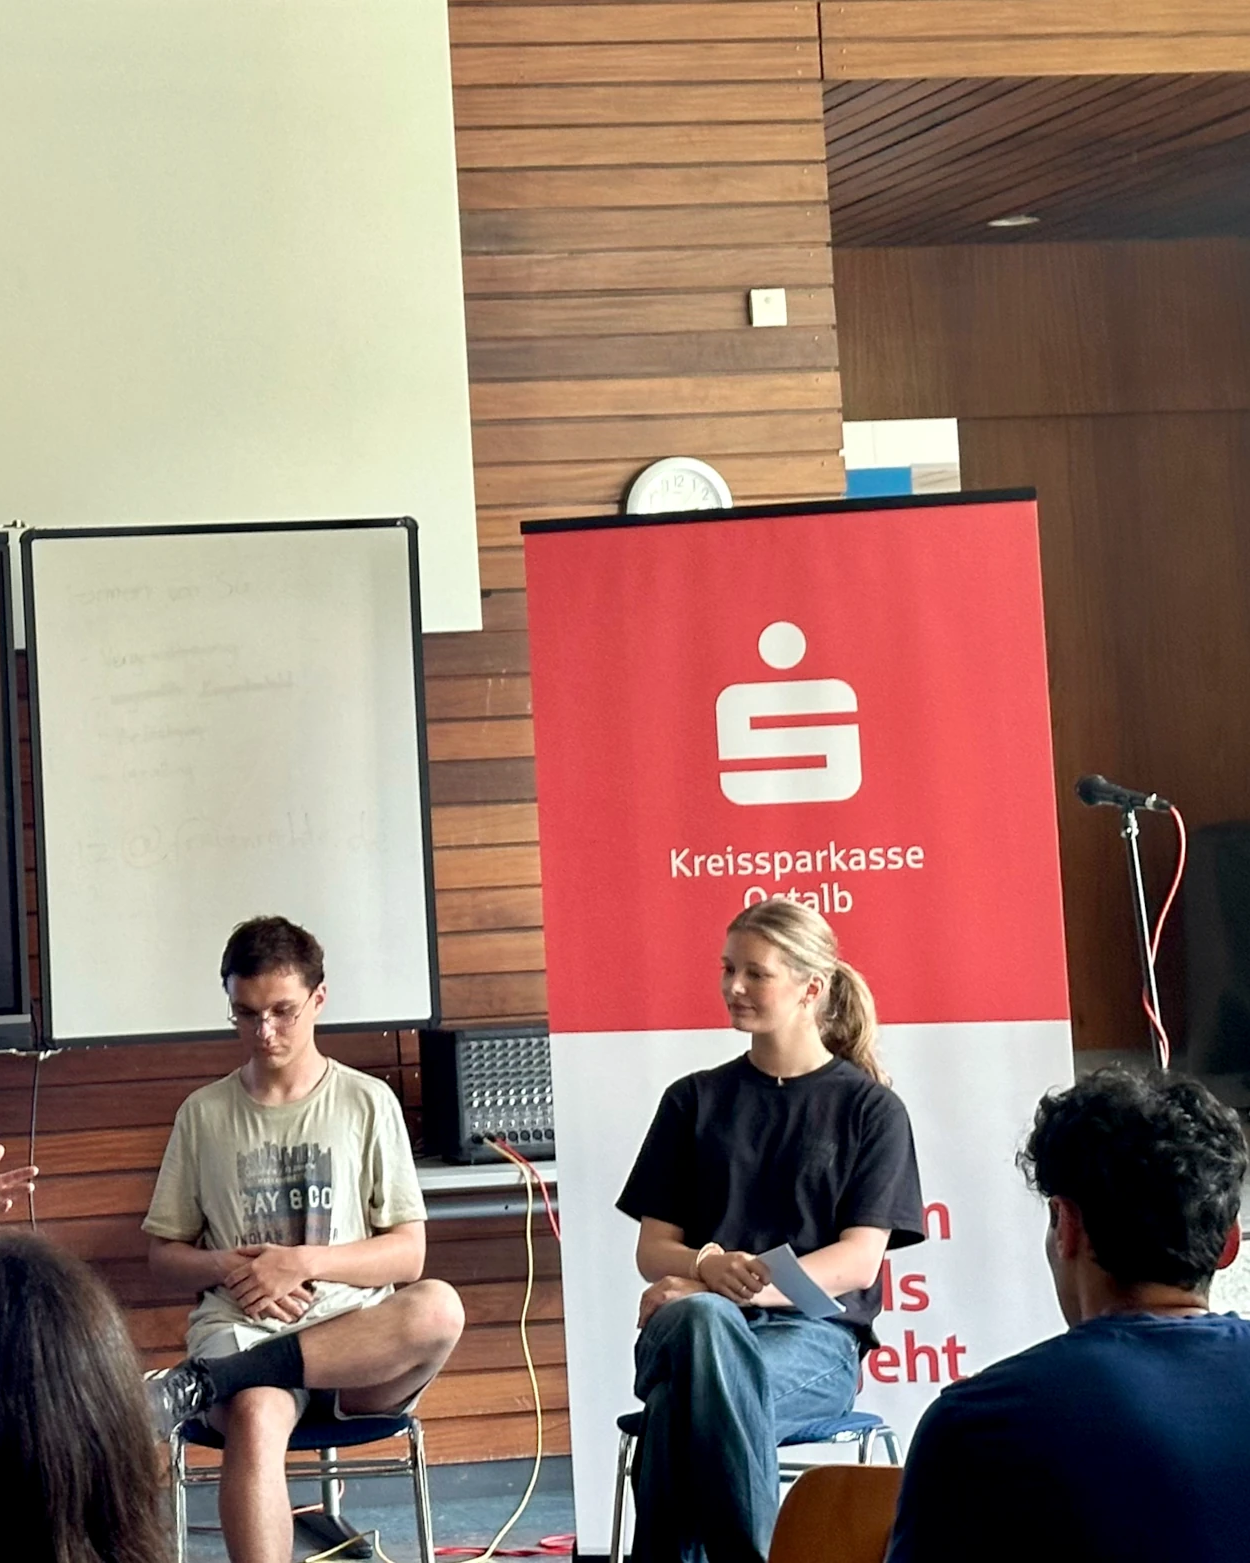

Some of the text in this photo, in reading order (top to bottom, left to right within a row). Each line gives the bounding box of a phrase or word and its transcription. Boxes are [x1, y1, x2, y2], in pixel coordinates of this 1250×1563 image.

[674, 474, 684, 488] 12
[702, 487, 710, 501] 2
[670, 841, 925, 881] Kreissparkasse
[857, 1330, 968, 1390] eht
